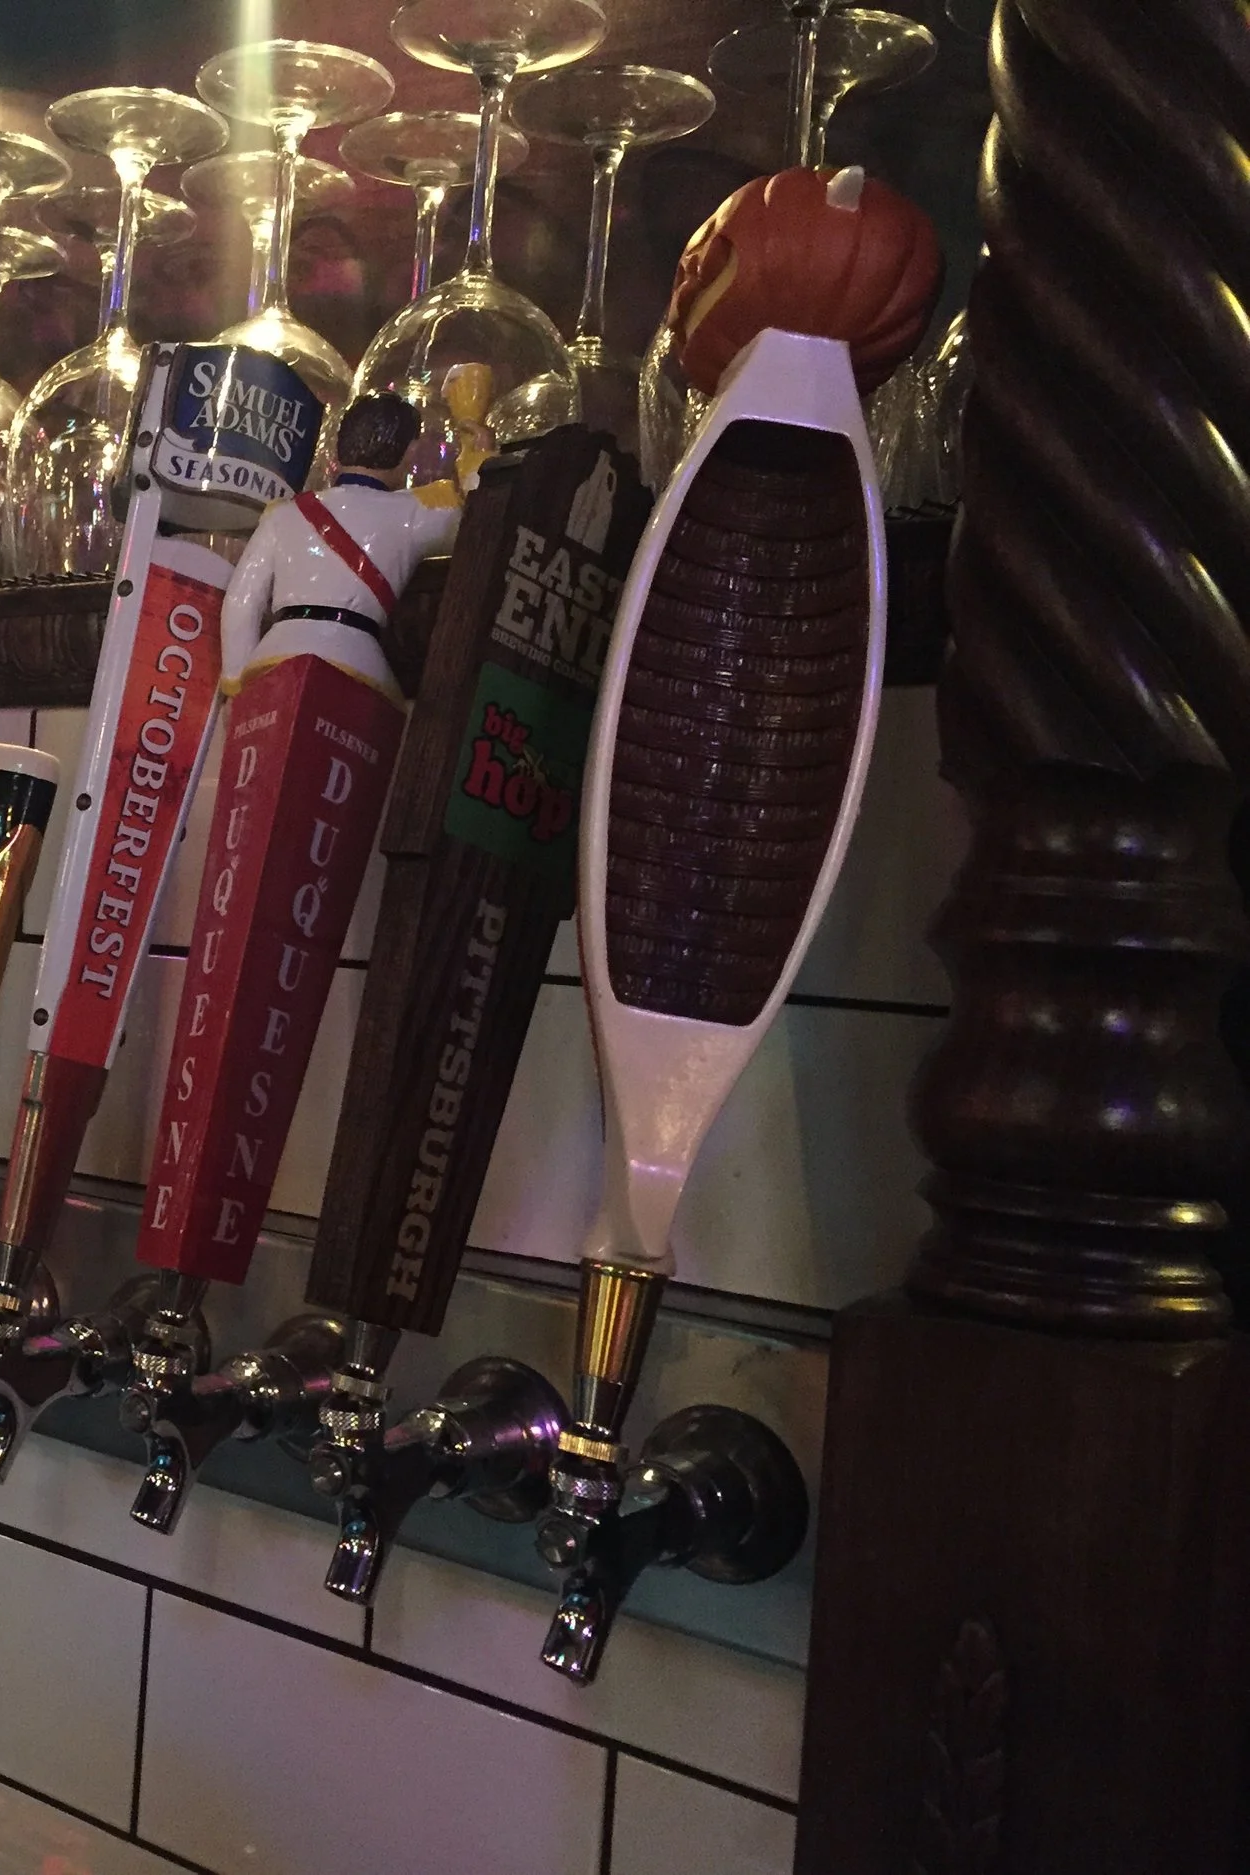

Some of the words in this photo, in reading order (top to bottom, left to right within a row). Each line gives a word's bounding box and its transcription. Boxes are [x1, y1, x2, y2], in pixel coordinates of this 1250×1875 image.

[189, 362, 306, 438] SAMUEL
[190, 398, 294, 462] ADAMS
[314, 716, 379, 765] PILSENER
[484, 703, 530, 756] big
[82, 604, 203, 999] OCTOBERFEST
[464, 738, 574, 842] hop
[386, 899, 507, 1302] PITTSBURGH
